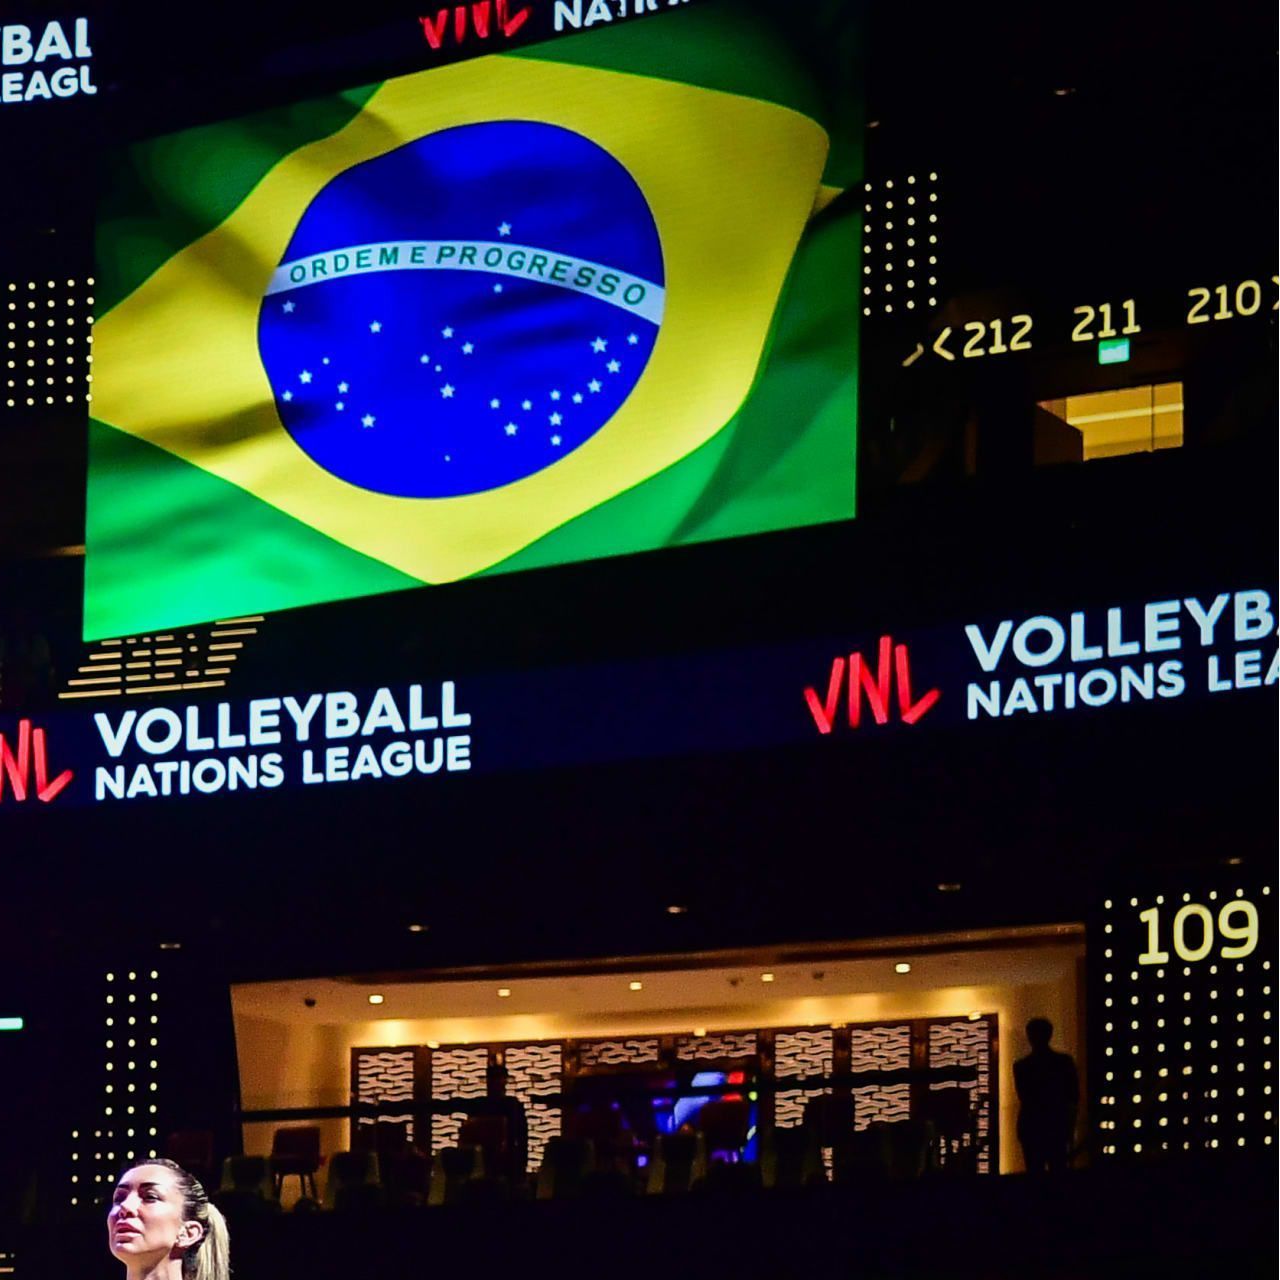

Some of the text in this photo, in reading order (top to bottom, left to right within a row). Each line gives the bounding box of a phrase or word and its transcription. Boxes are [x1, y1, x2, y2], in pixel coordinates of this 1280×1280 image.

[290, 245, 646, 306] ORDEM E PROGRESSO
[963, 280, 1261, 358] 212 211 210
[964, 589, 1278, 672] VOLLEYB
[94, 681, 472, 757] VOLLEYBALL
[803, 635, 941, 734] VNL
[966, 660, 1186, 720] NATIONS
[95, 734, 471, 801] NATIONS LEAGUE
[1137, 898, 1260, 967] 109
